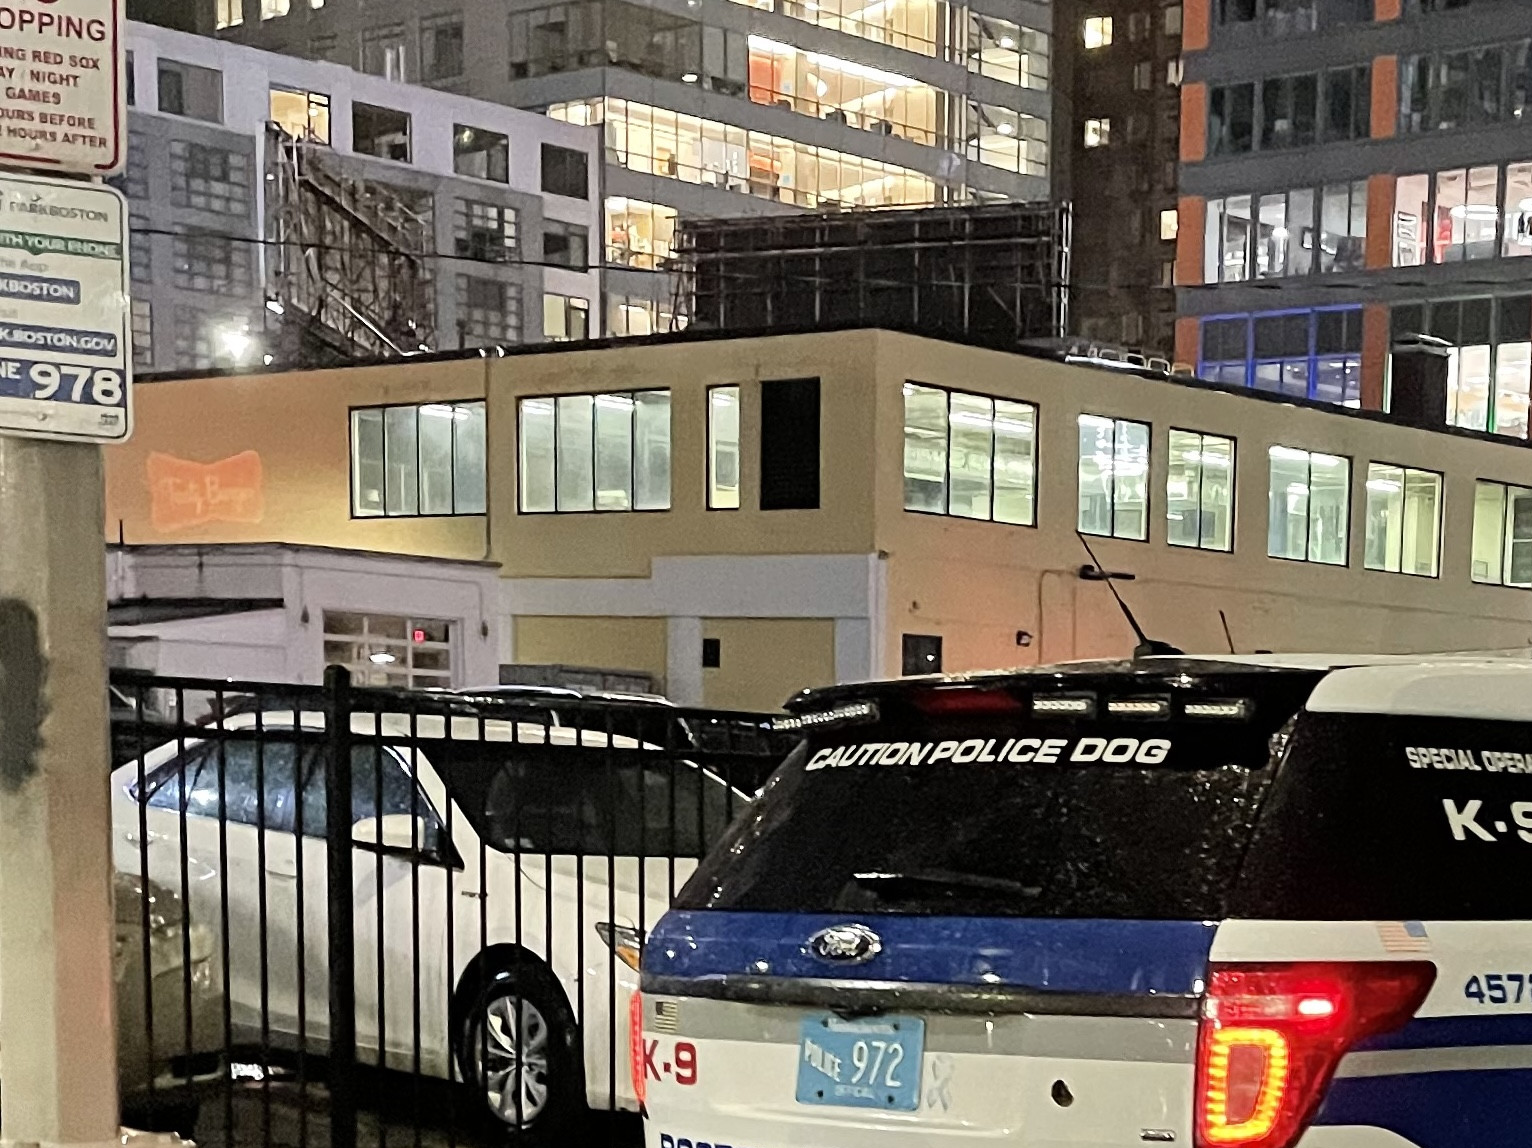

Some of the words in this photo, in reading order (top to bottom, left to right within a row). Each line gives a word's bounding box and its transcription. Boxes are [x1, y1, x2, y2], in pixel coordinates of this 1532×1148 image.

[32, 50, 63, 65] RED
[69, 54, 100, 71] SOX
[30, 69, 80, 87] NIGHT
[5, 86, 61, 105] GAMES
[39, 112, 95, 130] BEFORE
[7, 125, 57, 142] HOURS
[62, 132, 107, 148] AFTER
[29, 363, 122, 405] 978
[804, 742, 933, 771] CAUTION
[927, 738, 1069, 765] POLICE
[1069, 737, 1172, 764] DOG
[1405, 746, 1483, 771] SPECIAL
[851, 1040, 904, 1088] 972
